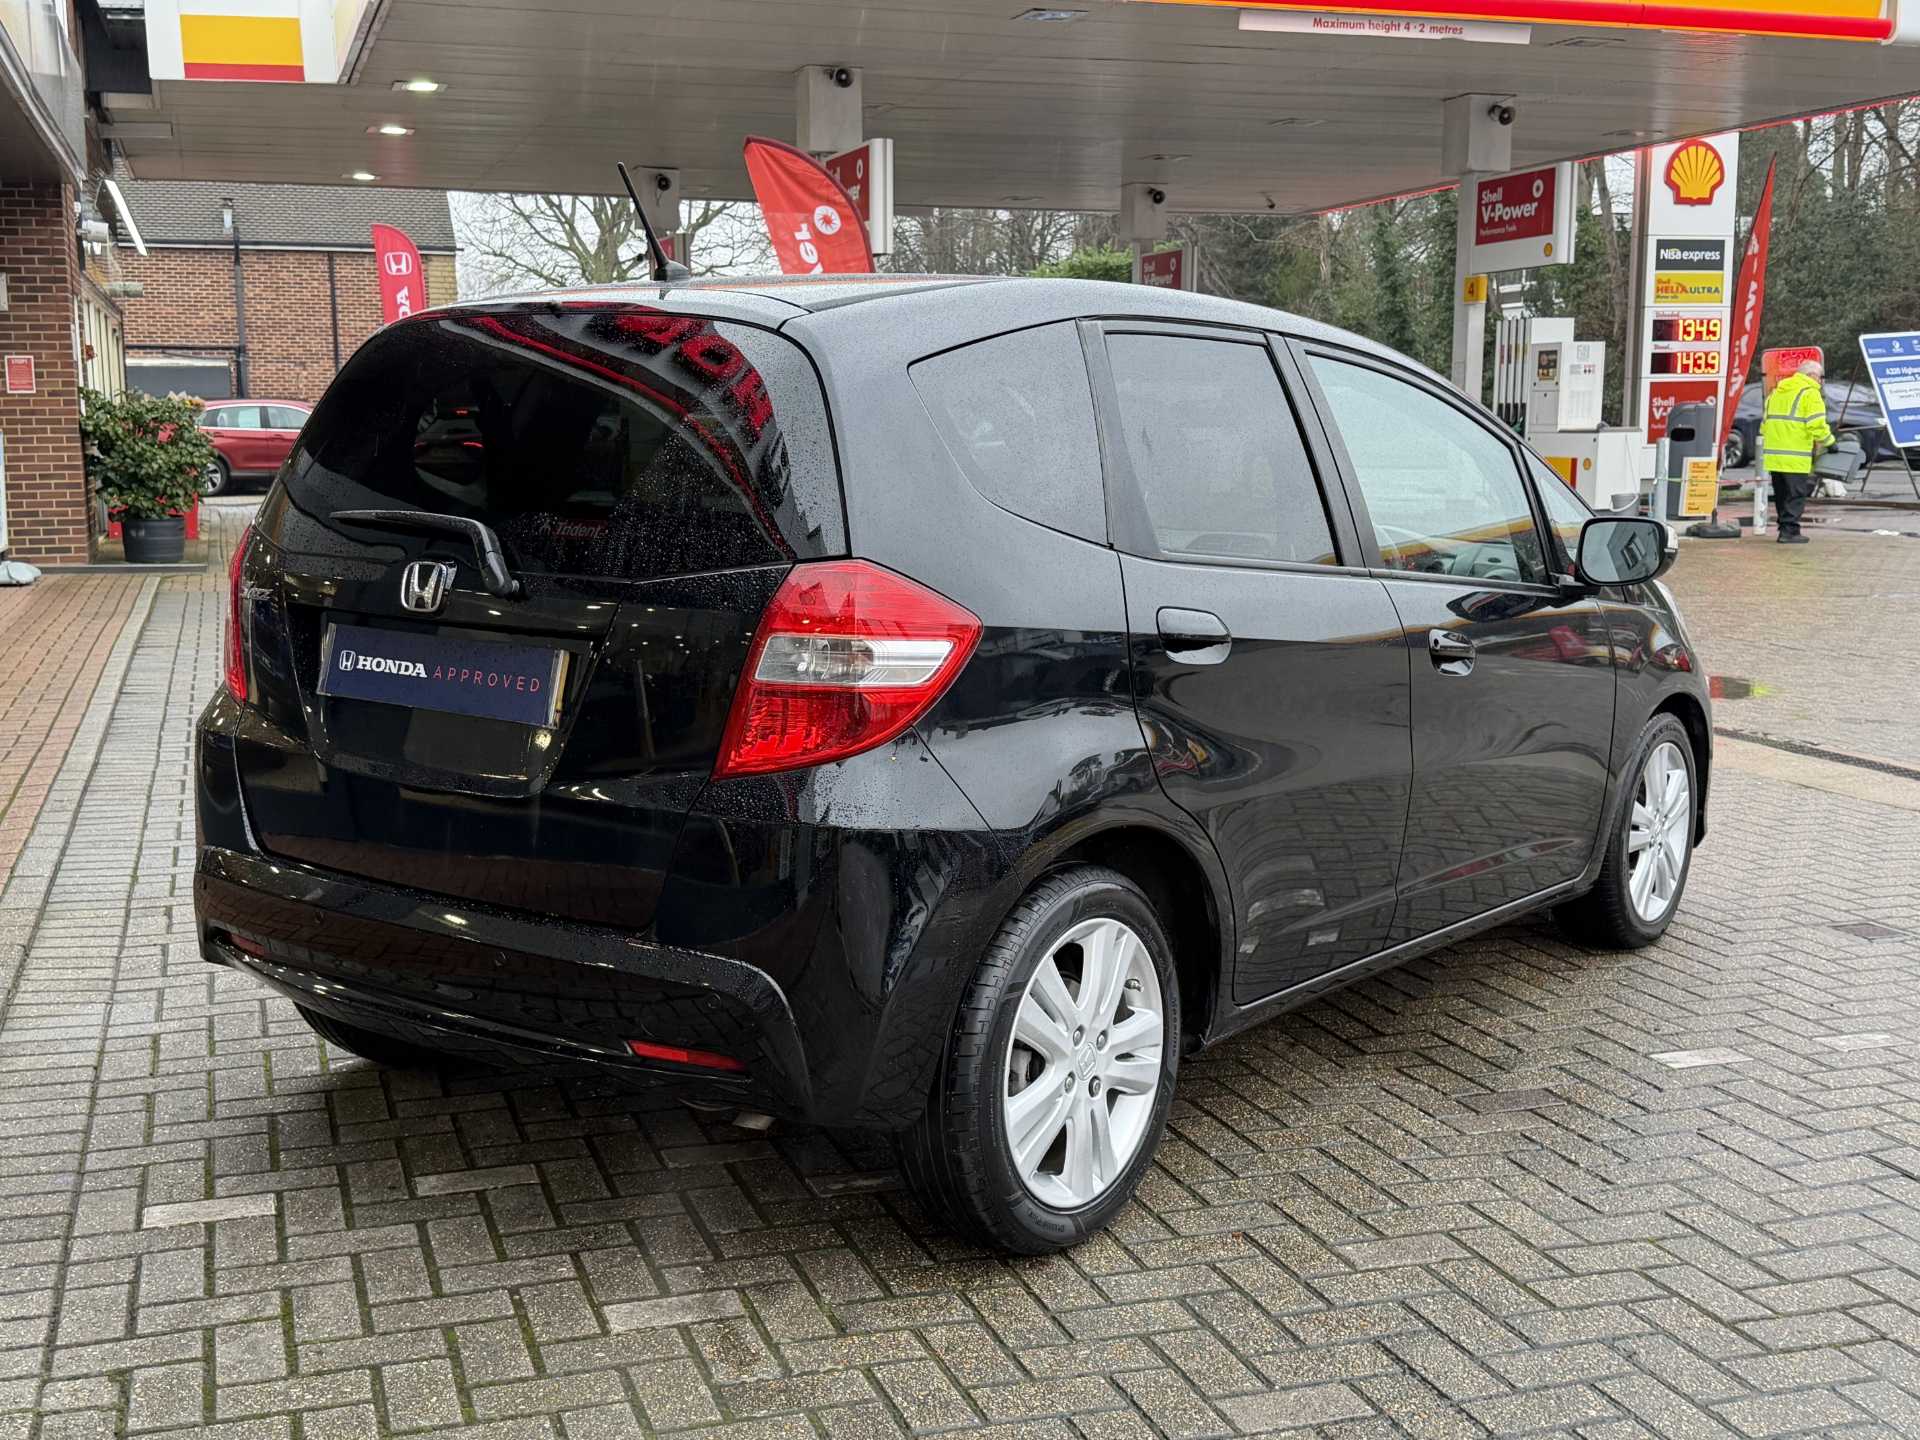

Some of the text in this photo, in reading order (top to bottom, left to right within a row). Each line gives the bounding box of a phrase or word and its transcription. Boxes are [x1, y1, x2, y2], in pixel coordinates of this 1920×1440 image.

[1312, 17, 1365, 31] Maximum
[1368, 19, 1401, 33] height
[1429, 24, 1464, 35] metres
[1481, 187, 1502, 204] Shell
[1481, 202, 1538, 223] V-Power
[1468, 281, 1474, 297] 4
[1689, 286, 1720, 294] ULTRA
[1678, 319, 1721, 341] 134.9
[1676, 351, 1719, 374] 143.9
[1652, 396, 1676, 407] Shell
[356, 655, 541, 693] HONDA APPROVED
